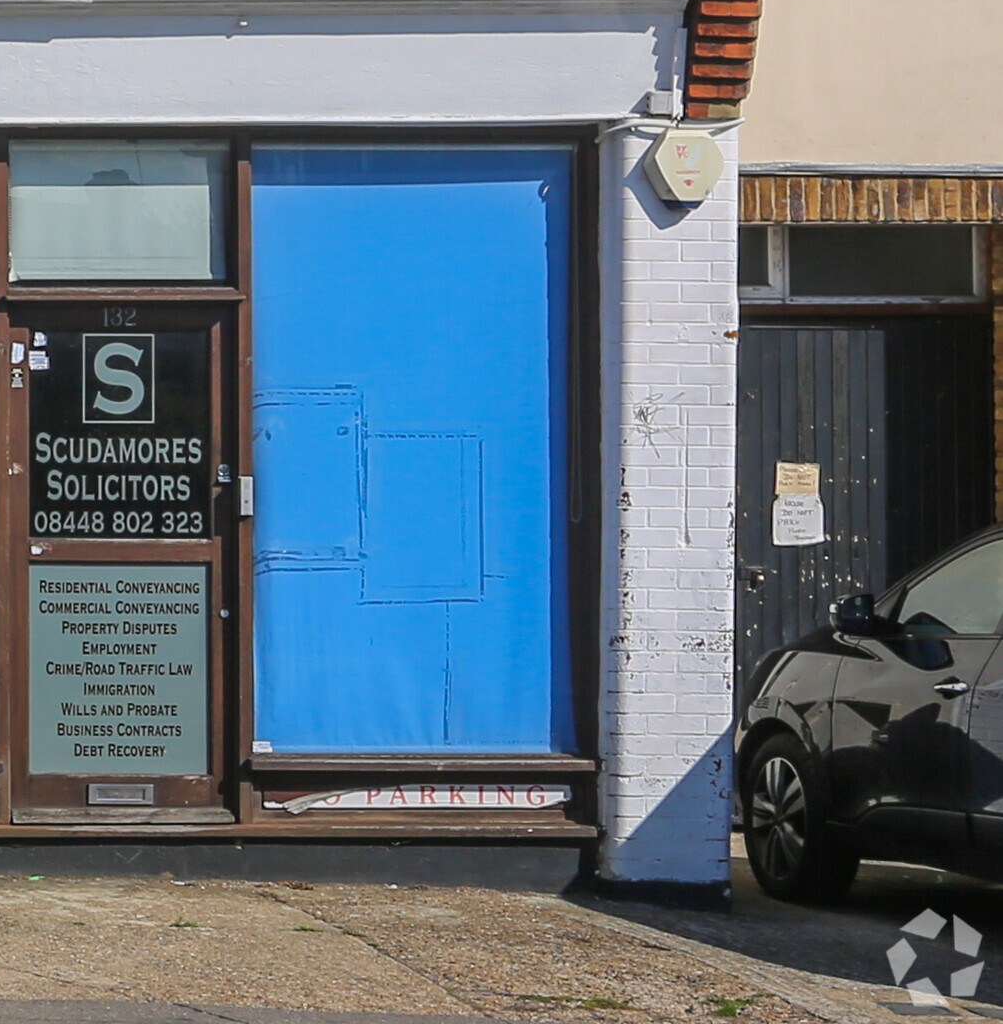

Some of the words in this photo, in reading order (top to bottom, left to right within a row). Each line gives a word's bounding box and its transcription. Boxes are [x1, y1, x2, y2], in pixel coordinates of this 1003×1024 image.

[103, 307, 137, 327] 132
[92, 342, 145, 415] S
[35, 432, 203, 464] SCUDAMORES
[47, 469, 191, 501] SOLICITORS
[34, 511, 105, 533] 08448
[112, 511, 154, 533] 802
[161, 511, 203, 533] 323
[39, 580, 112, 594] RESIDENTIAL
[116, 580, 200, 594] CONVEYANCING
[39, 600, 112, 614] COMMERCIAL
[115, 600, 200, 614] CONVEYANCING
[62, 621, 119, 635] PROPERTY
[123, 621, 178, 635] DISPUTES
[82, 641, 157, 655] EMPLOYMENT
[45, 662, 115, 677] CRIME/ROAD
[119, 662, 165, 675] TRAFFIC
[169, 662, 193, 675] LAW
[83, 682, 156, 696] IMMIGRATION
[61, 703, 97, 716] WILLS
[101, 704, 124, 716] AND
[127, 703, 178, 716] PROBATE
[57, 723, 113, 736] BUSINESS
[117, 723, 182, 736] CONTRACTS
[74, 743, 104, 757] DEBT
[108, 743, 166, 757] RECOVERY
[365, 785, 547, 806] PARKING
